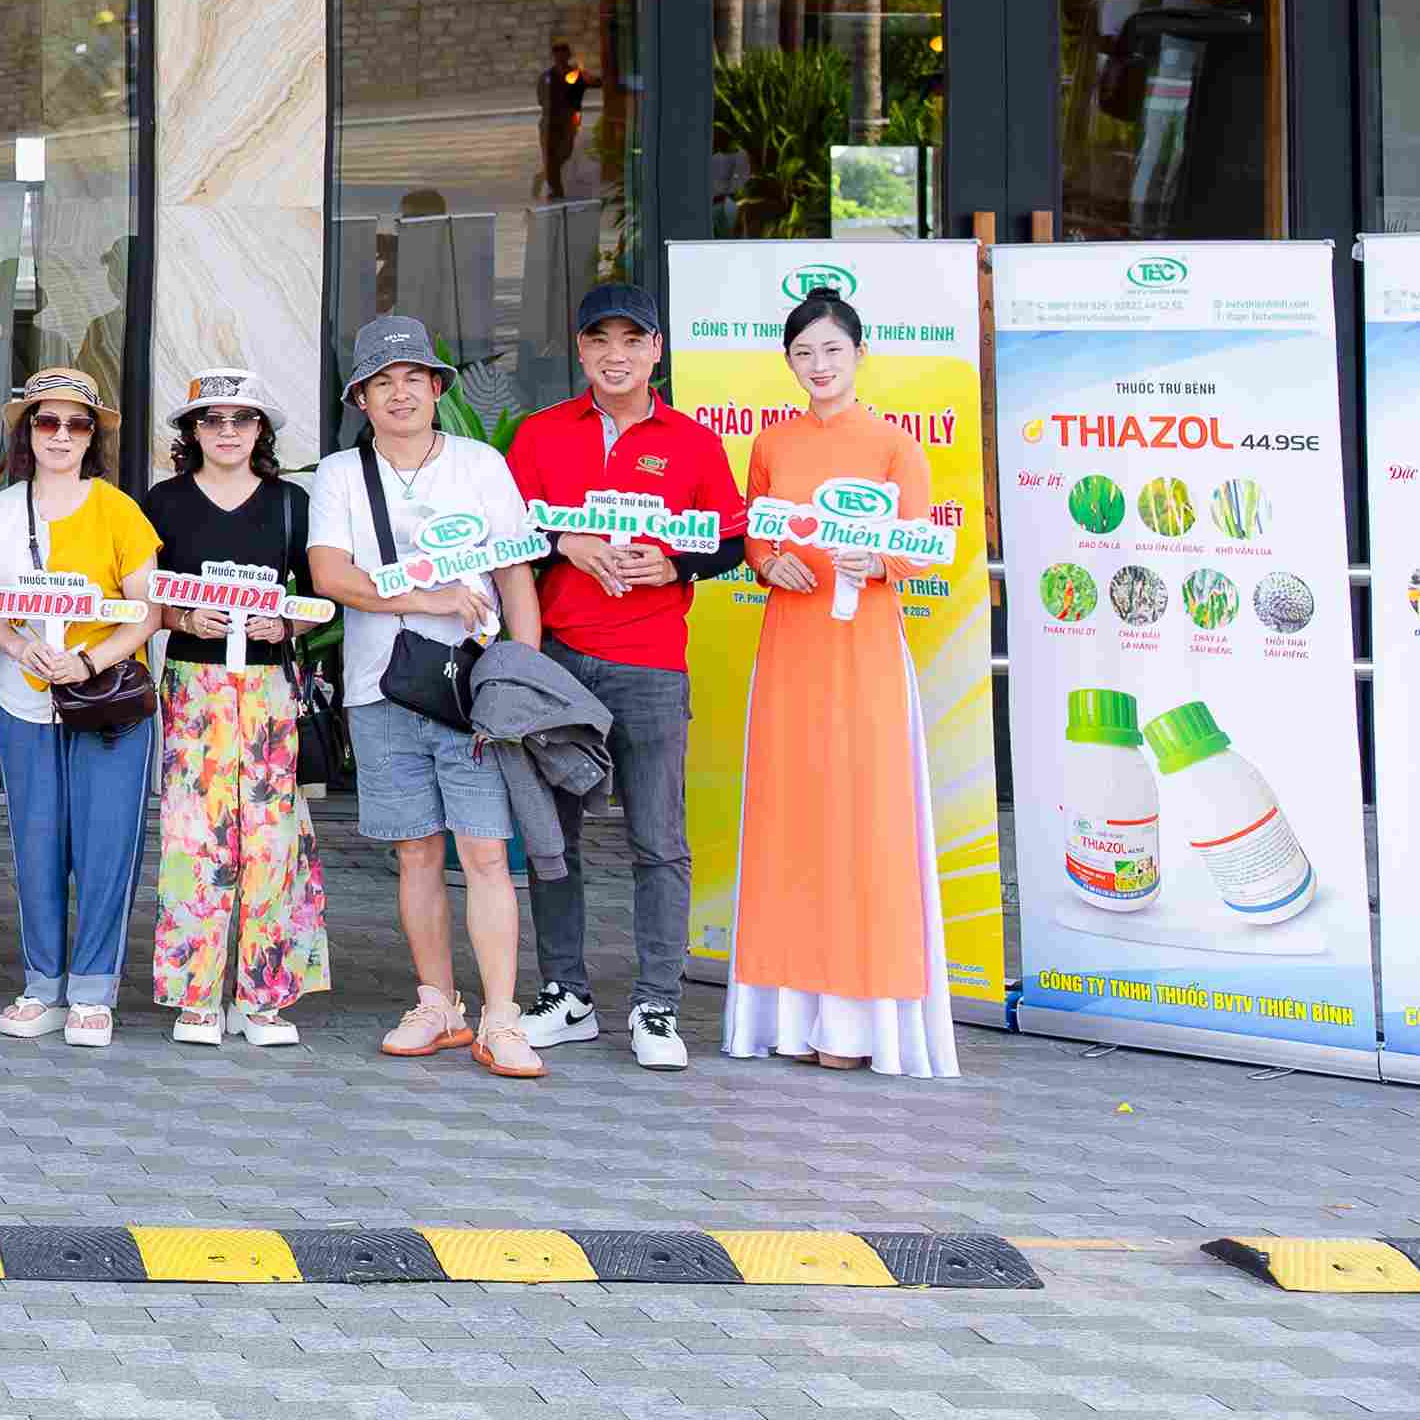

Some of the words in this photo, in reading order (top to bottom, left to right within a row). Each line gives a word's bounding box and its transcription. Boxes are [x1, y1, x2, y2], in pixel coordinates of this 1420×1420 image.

[691, 320, 729, 337] CÔNG
[733, 323, 748, 338] TY
[876, 321, 916, 341] THIÊN
[929, 408, 955, 445] LÝ
[1051, 414, 1234, 450] THIAZOL
[527, 501, 637, 534] Azobin
[645, 511, 716, 538] Gold
[820, 519, 882, 549] Thiên
[376, 565, 408, 593] Tôi
[433, 550, 490, 580] Thiên
[494, 531, 547, 563] Bình
[699, 540, 715, 551] SC
[155, 576, 281, 612] THIMIDA
[1080, 835, 1127, 856] THIAZOL
[1039, 968, 1083, 994] CÔNG
[1086, 975, 1106, 996] TY
[1110, 978, 1152, 1003] TNHH
[1156, 980, 1209, 1010] THUỐC
[1213, 991, 1253, 1014] BVTV
[1258, 993, 1307, 1021] THIÊN
